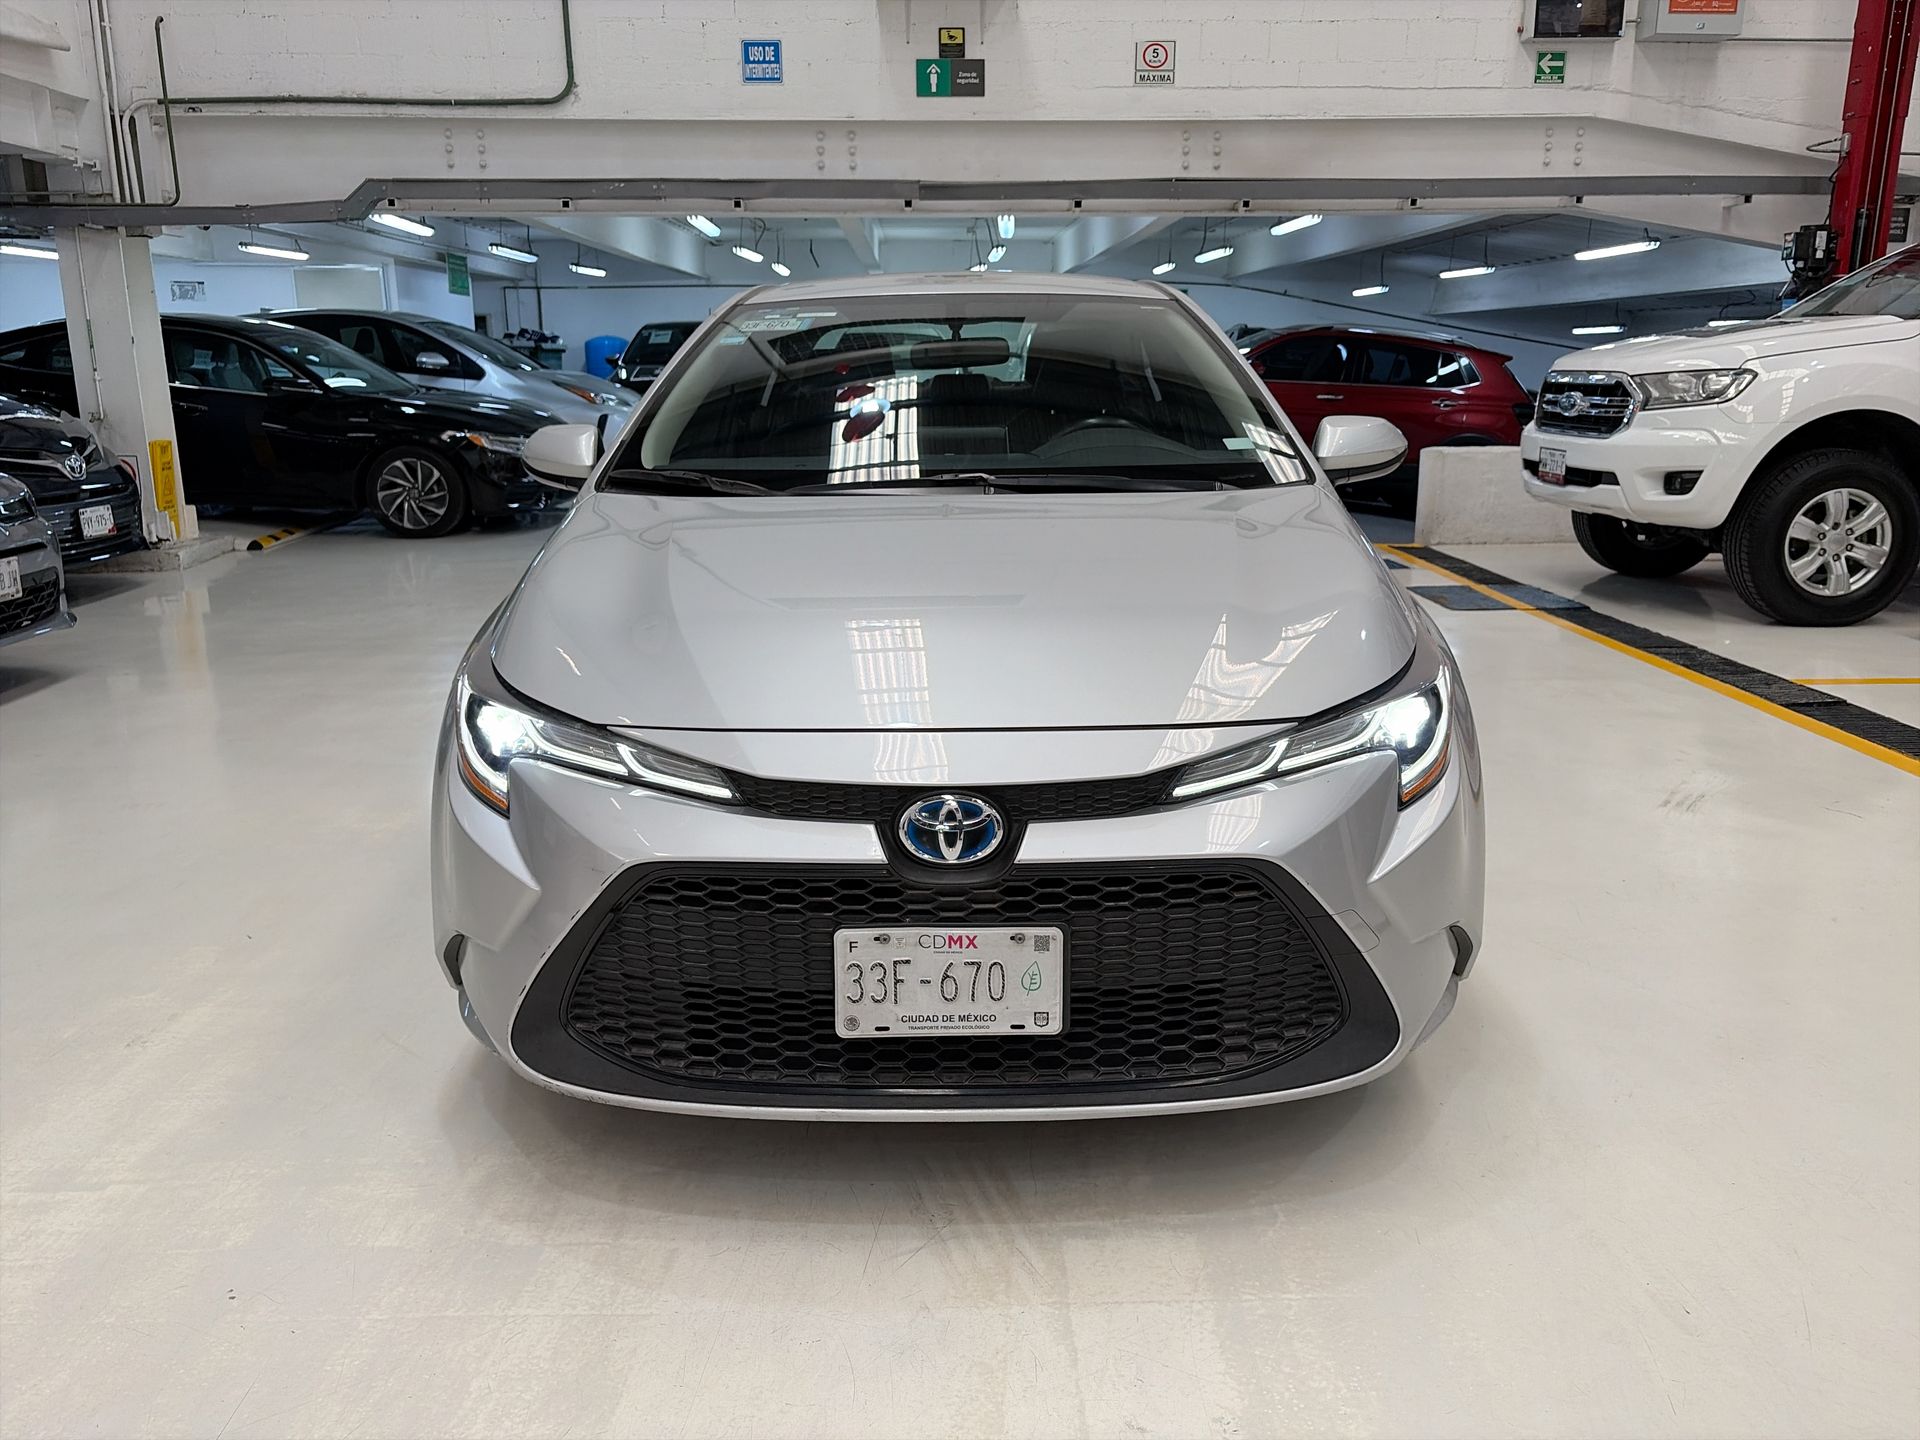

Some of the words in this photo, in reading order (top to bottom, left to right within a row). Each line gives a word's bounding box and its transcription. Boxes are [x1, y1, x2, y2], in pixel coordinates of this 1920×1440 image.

[748, 46, 764, 61] USO
[765, 46, 775, 61] DE
[1152, 48, 1160, 59] 5
[1139, 72, 1172, 82] MÁXIMA
[849, 941, 858, 953] F
[918, 934, 978, 949] CDMX
[901, 1014, 939, 1023] CIUDAD
[942, 1014, 955, 1023] DE
[958, 1012, 997, 1022] MÉXICO
